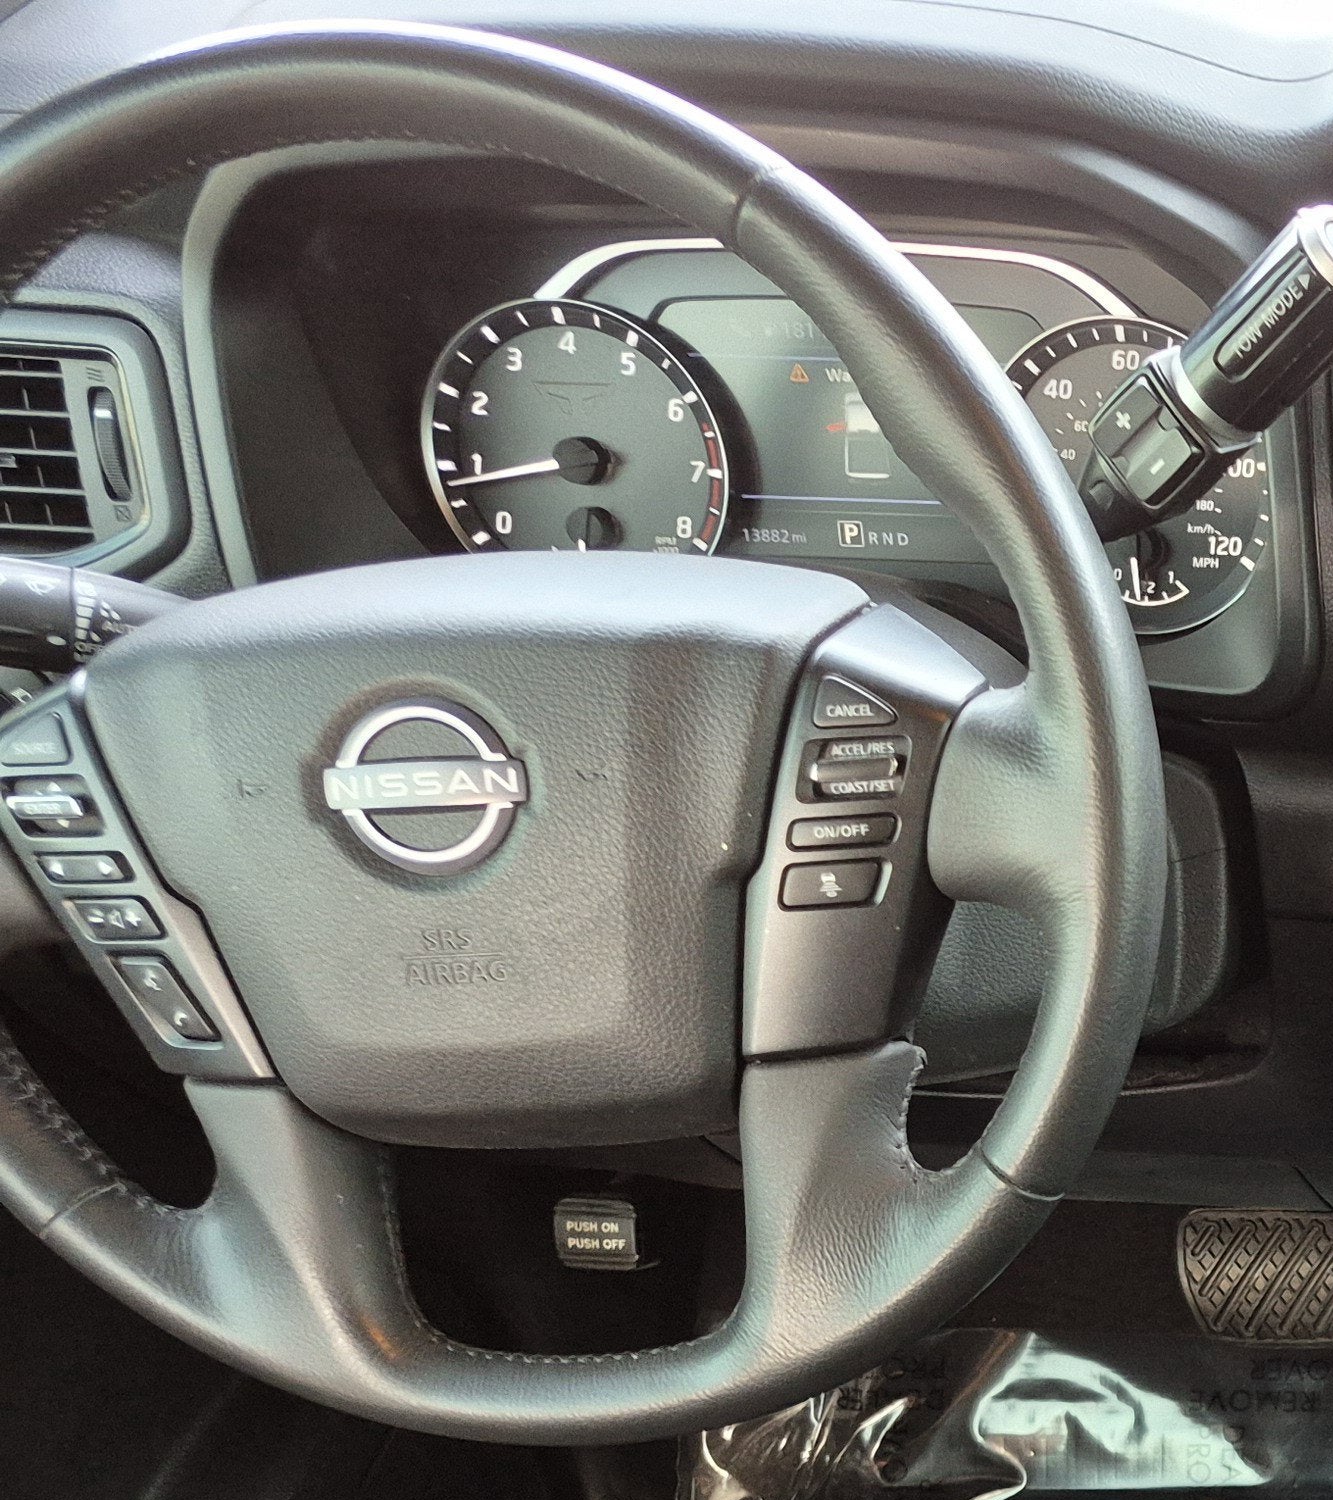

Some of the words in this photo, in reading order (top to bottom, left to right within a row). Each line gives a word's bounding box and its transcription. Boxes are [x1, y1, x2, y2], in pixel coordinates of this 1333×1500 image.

[1232, 327, 1264, 361] TOW
[1263, 282, 1303, 331] MODE
[557, 330, 576, 354] 4
[506, 346, 522, 372] 3
[620, 352, 636, 376] 5
[1111, 349, 1140, 370] 60
[1043, 378, 1073, 399] 40
[471, 390, 489, 416] 2
[667, 397, 684, 422] 6
[471, 453, 482, 476] 1
[1060, 448, 1076, 460] 40
[690, 460, 705, 483] 7
[1195, 499, 1215, 511] 180
[495, 511, 512, 534] 0
[676, 516, 692, 539] 8
[1187, 523, 1214, 534] km/h
[844, 525, 858, 543] P
[868, 532, 879, 545] R
[882, 532, 893, 545] N
[897, 533, 909, 546] D
[1208, 536, 1243, 556] 120
[1192, 556, 1220, 569] MPH
[825, 703, 874, 718] CANCEL
[830, 740, 895, 757] ACCEL/RES
[328, 767, 520, 802] NISSAN
[814, 823, 870, 838] ON/OFF
[420, 927, 474, 951] SRS
[404, 958, 508, 986] AIRBAG
[566, 1220, 598, 1233] PUSH
[601, 1221, 620, 1234] ON
[567, 1237, 600, 1250] PUSH
[602, 1238, 626, 1251] OFF
